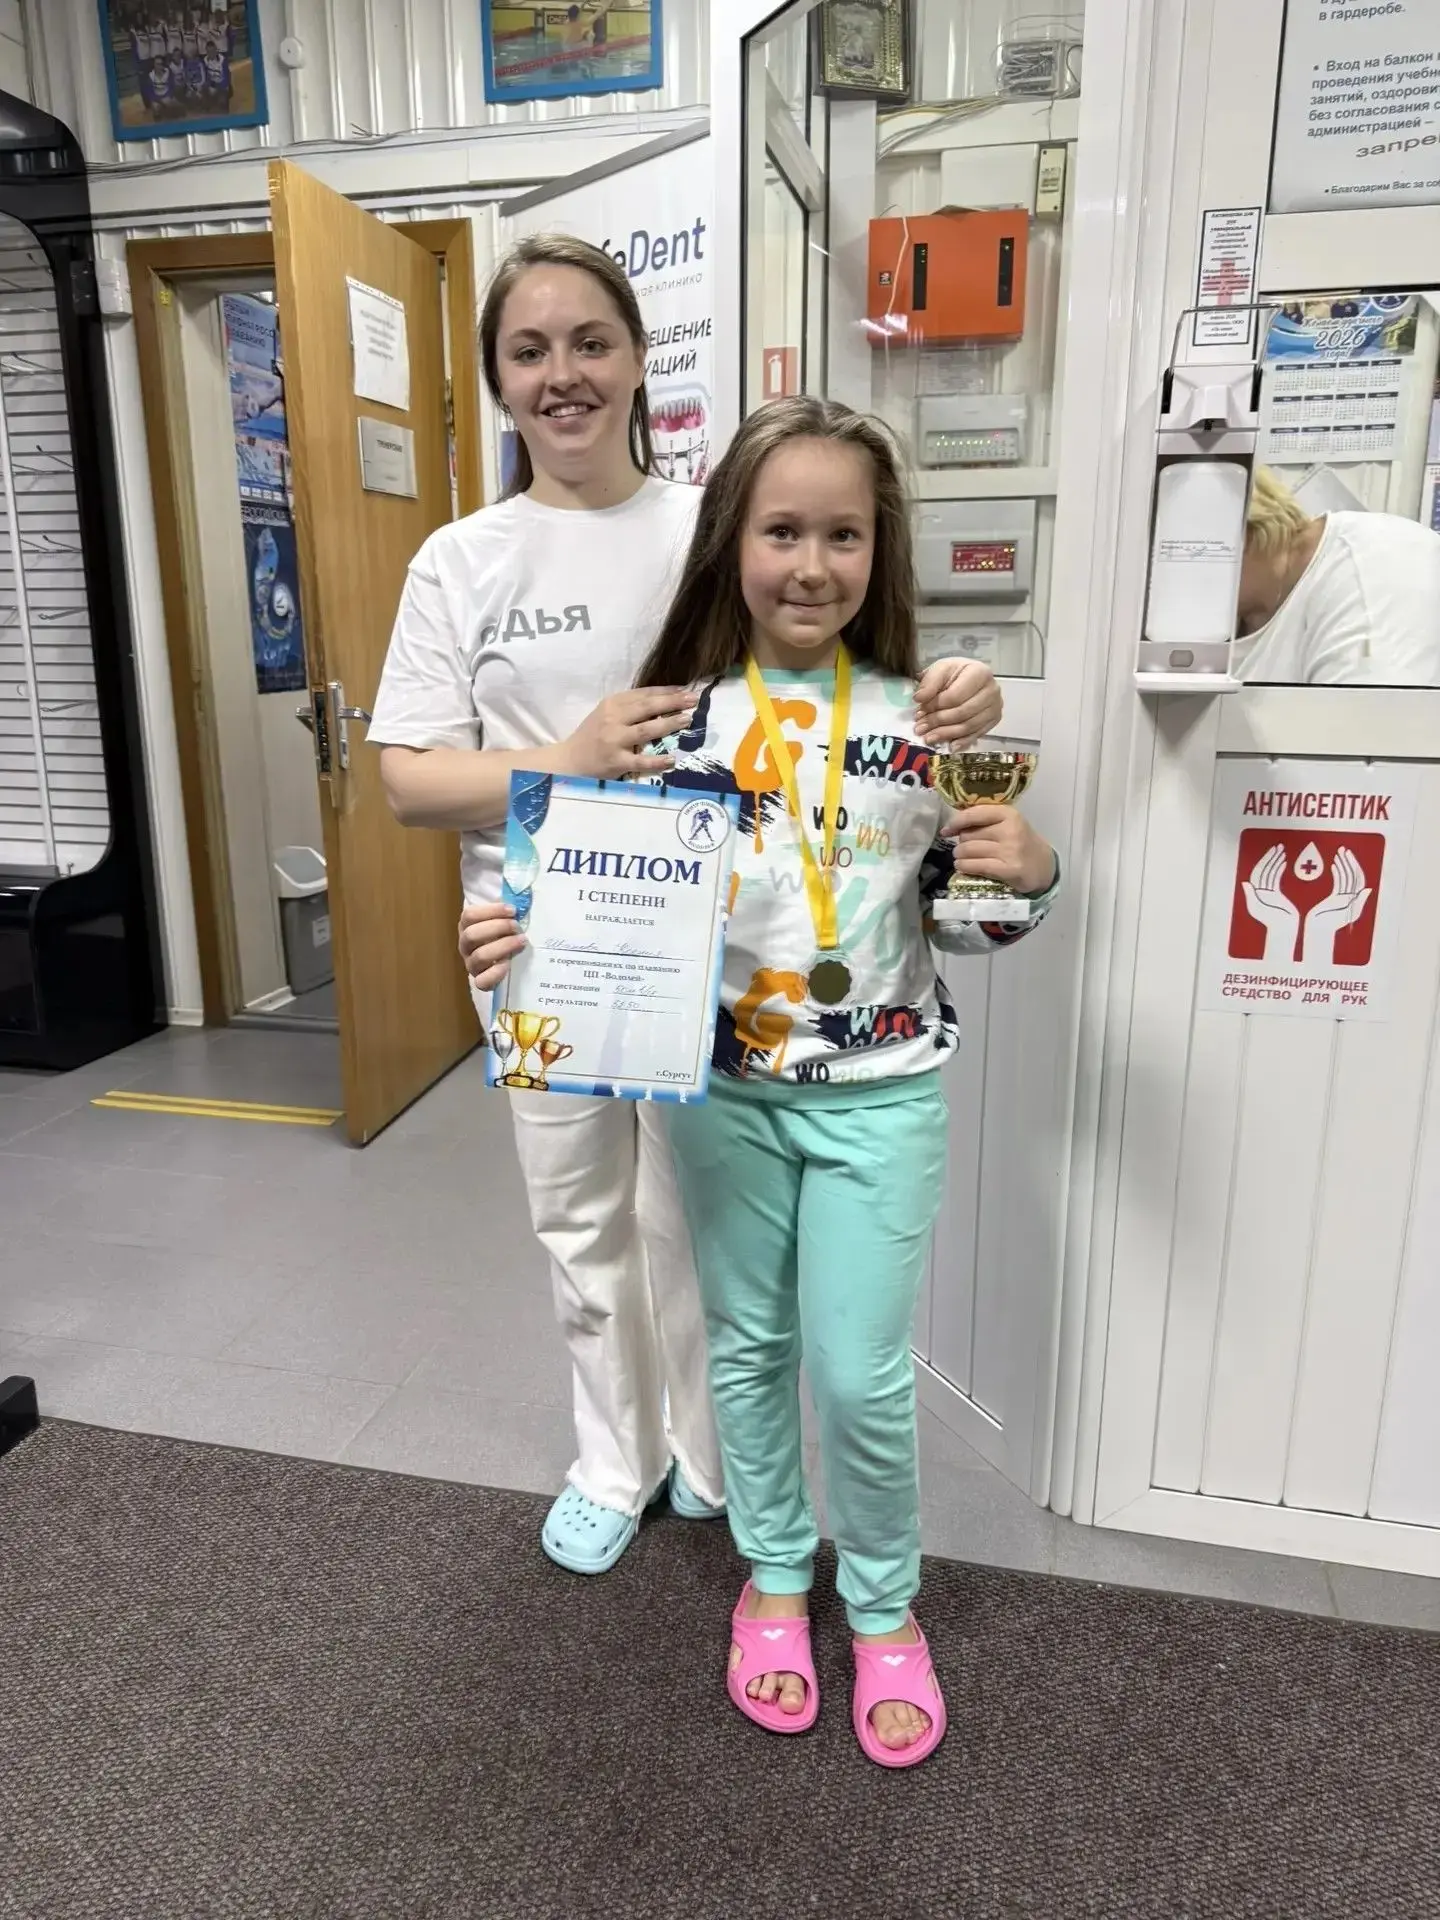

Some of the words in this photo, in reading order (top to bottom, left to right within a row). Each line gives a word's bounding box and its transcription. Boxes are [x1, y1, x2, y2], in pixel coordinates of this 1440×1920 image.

[1319, 12, 1327, 21] в
[1331, 3, 1406, 21] гардеробе.
[1326, 60, 1361, 72] Вход
[1364, 59, 1380, 68] на
[1384, 52, 1433, 66] балкон
[1312, 72, 1393, 90] проведения
[1310, 91, 1367, 105] занятий,
[1309, 110, 1332, 121] без
[1335, 99, 1430, 120] согласования
[1307, 116, 1421, 137] администрацией
[1355, 134, 1440, 159] запре
[1331, 181, 1391, 195] Благодарим
[1392, 181, 1412, 190] Вас
[1315, 327, 1367, 348] 2026
[1243, 790, 1392, 820] АНТИСЕПТИК
[547, 848, 702, 885] ДИПЛОМ
[578, 889, 584, 901] I
[588, 890, 666, 908] СТЕПЕНИ
[585, 913, 655, 926] НАГРАЖДАЕТСЯ
[557, 958, 623, 969] соревнованиях
[638, 965, 681, 974] плаванию
[584, 970, 599, 979] ЦП
[552, 983, 600, 993] дистанции
[1222, 973, 1369, 993] ДЕЗИНФИЦИРУЮЩЕЕ
[545, 997, 598, 1008] результатом
[1222, 986, 1292, 1000] СРЕДСТВО
[1301, 992, 1330, 1004] ДЛЯ
[1341, 994, 1368, 1006] РУК
